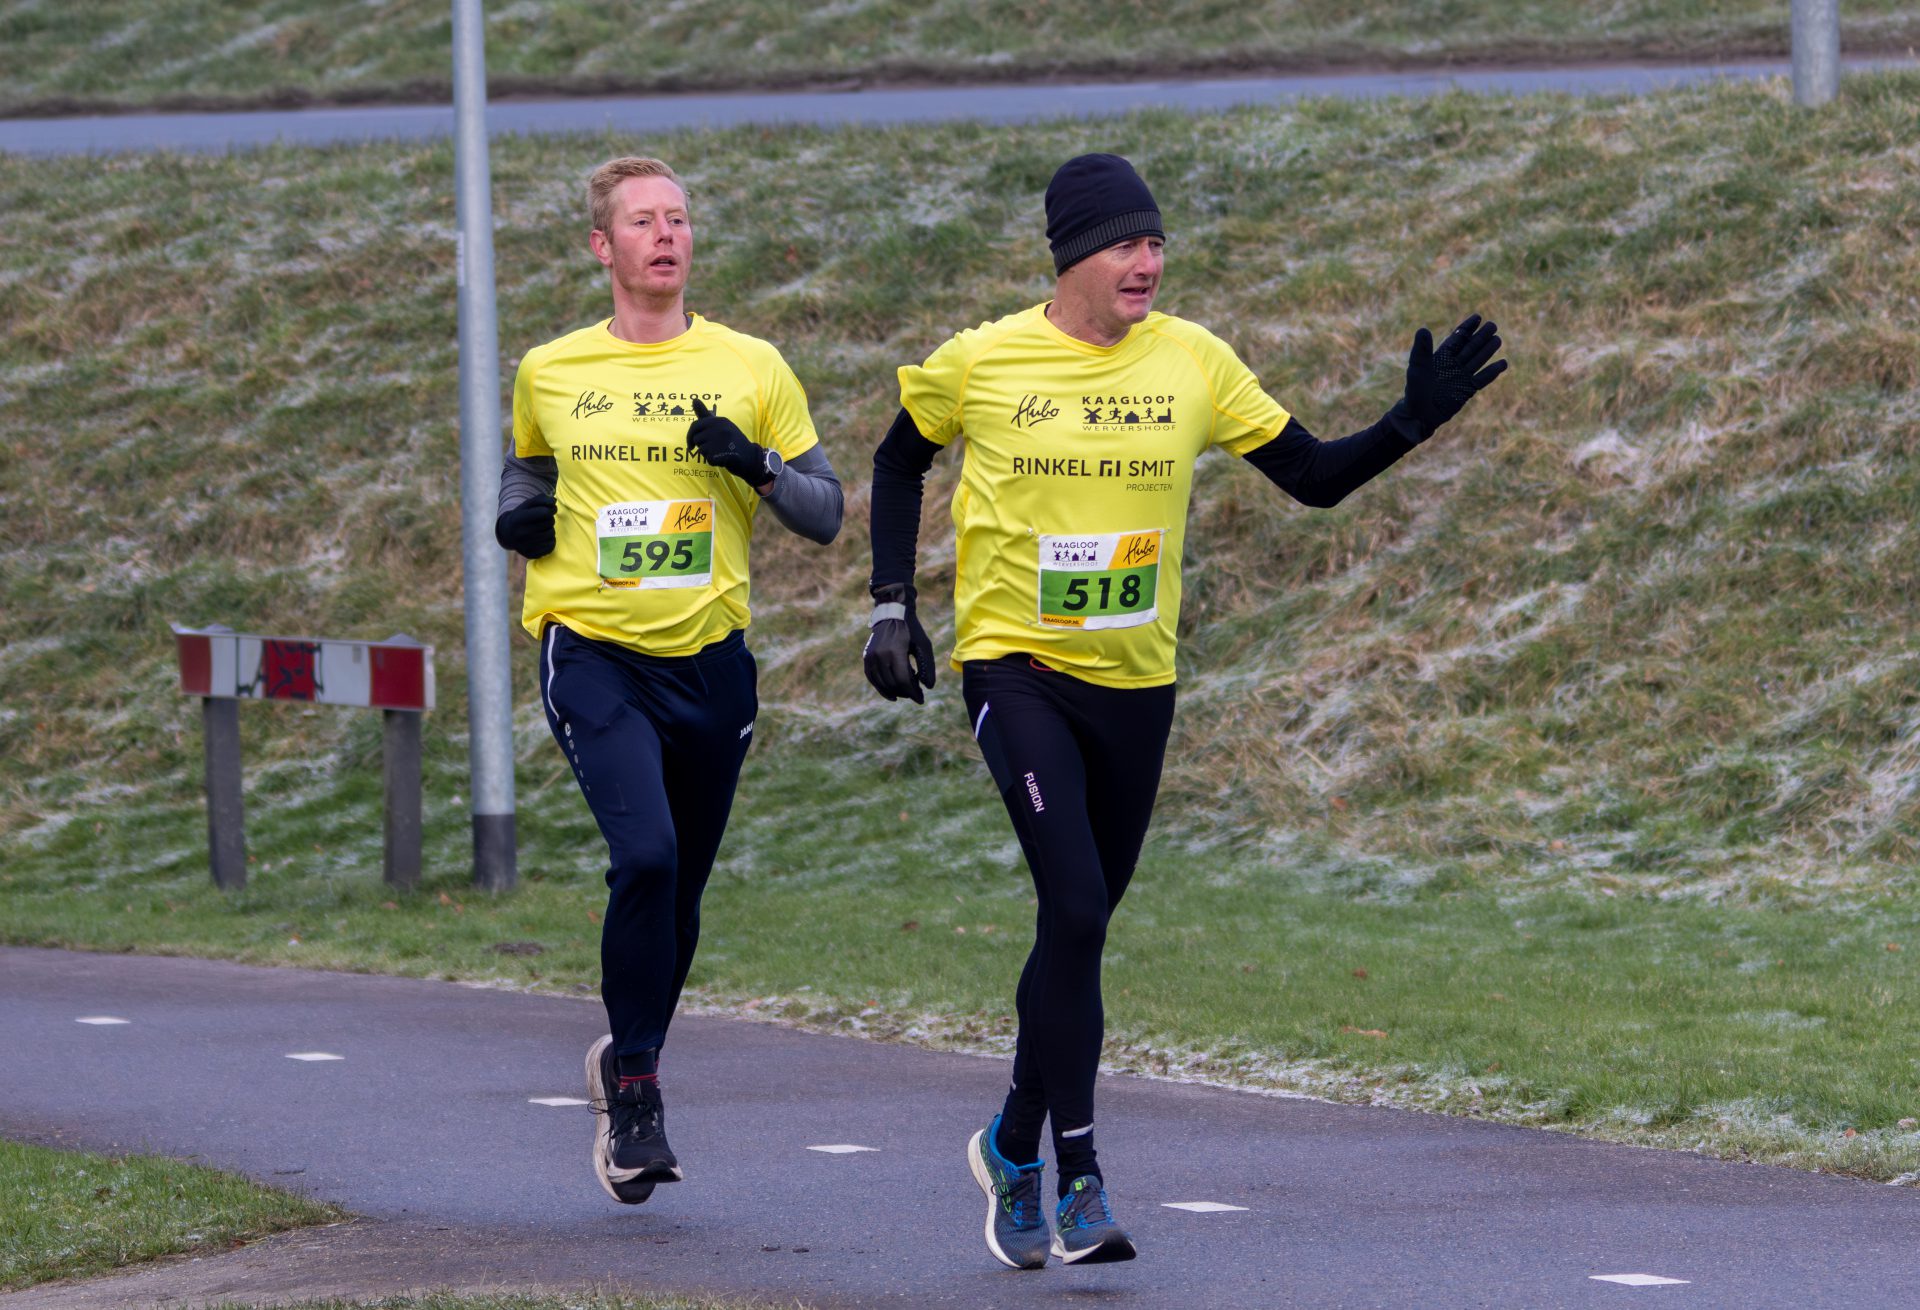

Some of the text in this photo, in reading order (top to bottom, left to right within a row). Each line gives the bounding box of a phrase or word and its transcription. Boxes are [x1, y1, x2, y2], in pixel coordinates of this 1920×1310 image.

[571, 391, 614, 419] Hubo
[633, 392, 722, 400] KAAGLOOP
[1082, 395, 1175, 405] KAAGLOOP
[1011, 394, 1060, 428] Hubo
[571, 444, 641, 461] RINKEL
[673, 468, 720, 478] PROJECTEN
[1013, 457, 1175, 477] RINKEL SMIT
[1126, 483, 1173, 492] PROJECTEN
[607, 507, 649, 516] KAAGLOOP
[674, 504, 708, 531] Hubo
[1052, 541, 1099, 549] KAAGLOOP
[1123, 536, 1156, 565] Hubo
[620, 539, 693, 573] 595
[1062, 574, 1141, 611] 518
[1024, 772, 1045, 813] FUSION
